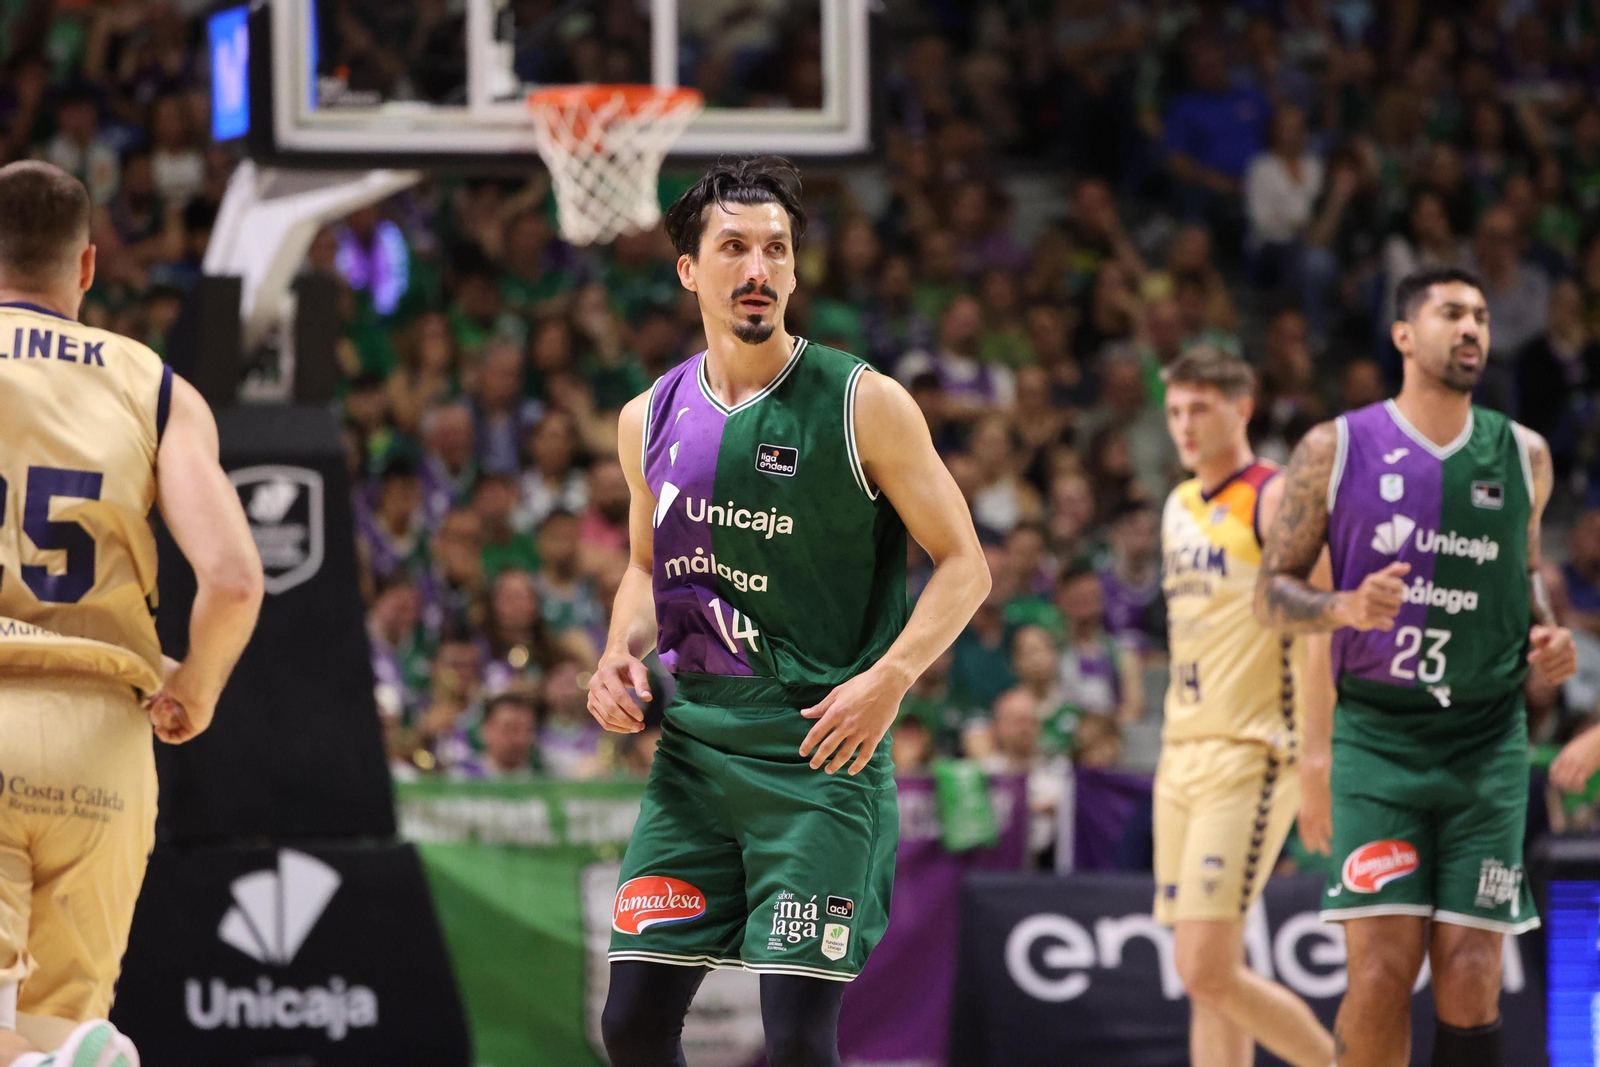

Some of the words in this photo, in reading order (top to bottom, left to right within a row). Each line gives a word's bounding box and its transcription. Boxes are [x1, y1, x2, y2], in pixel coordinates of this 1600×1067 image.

[760, 461, 793, 473] endesa
[761, 452, 777, 463] liga
[0, 465, 104, 604] 5
[686, 497, 794, 540] Unicaja
[1415, 527, 1499, 565] Unicaja
[664, 547, 768, 593] málaga
[708, 598, 760, 654] 14
[1390, 626, 1451, 684] 23
[9, 775, 65, 802] Costa
[617, 882, 702, 914] famadesa
[829, 905, 848, 916] acb
[185, 975, 378, 1042] Unicaja
